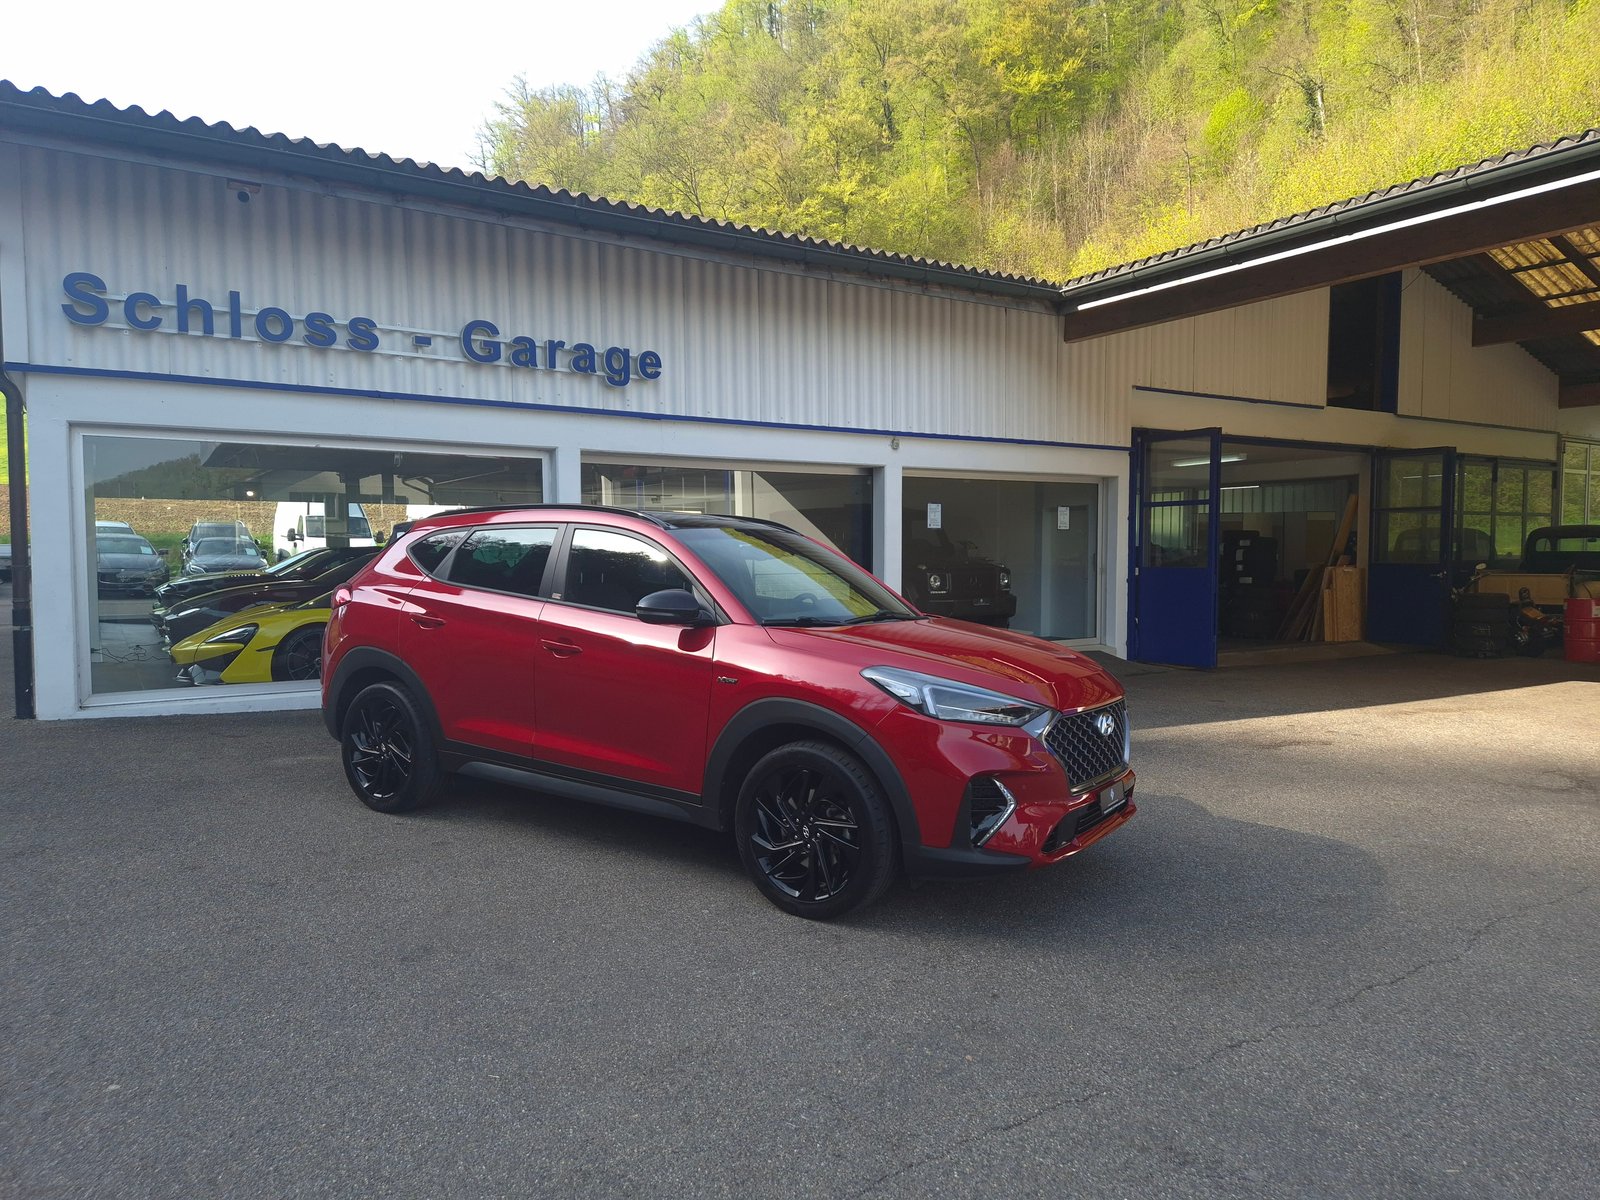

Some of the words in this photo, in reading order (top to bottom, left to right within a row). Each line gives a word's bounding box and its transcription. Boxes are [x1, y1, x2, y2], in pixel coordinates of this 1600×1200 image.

[61, 272, 380, 352] Schloss
[412, 335, 432, 347] -
[461, 319, 663, 387] Garage
